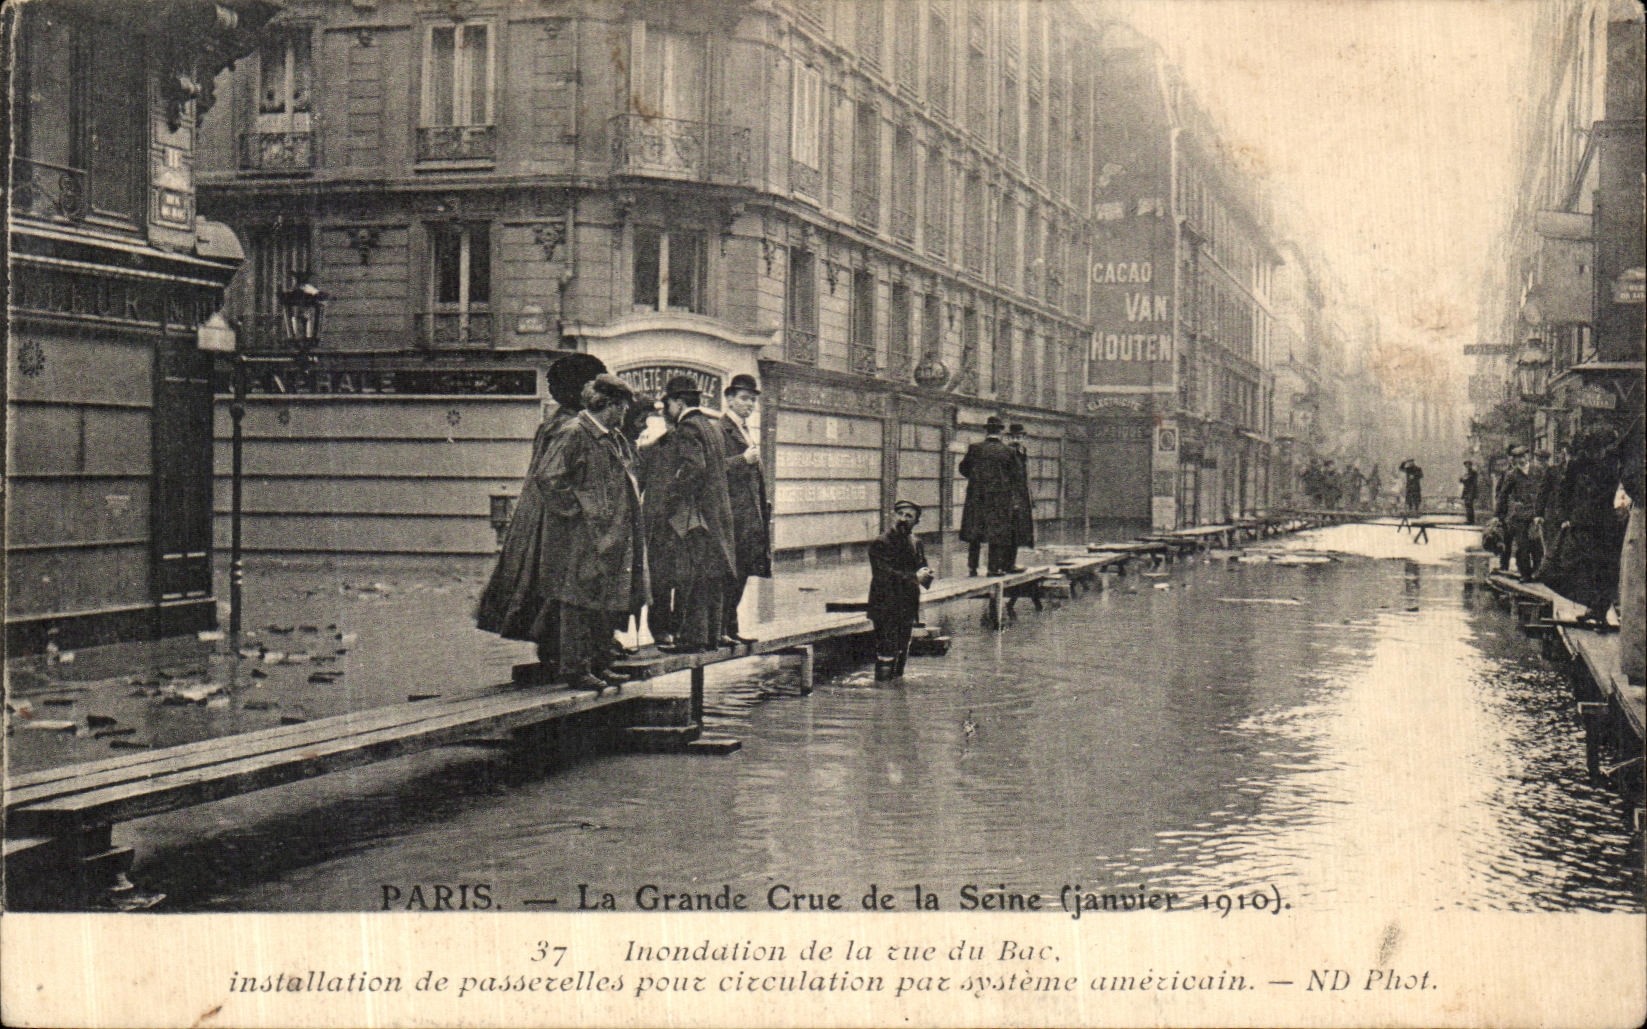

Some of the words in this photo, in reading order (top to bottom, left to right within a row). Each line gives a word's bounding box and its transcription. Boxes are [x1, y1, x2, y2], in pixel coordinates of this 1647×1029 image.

[1092, 262, 1151, 283] CACAO
[1125, 292, 1169, 322] VAN
[1090, 331, 1172, 361] HOUTEN
